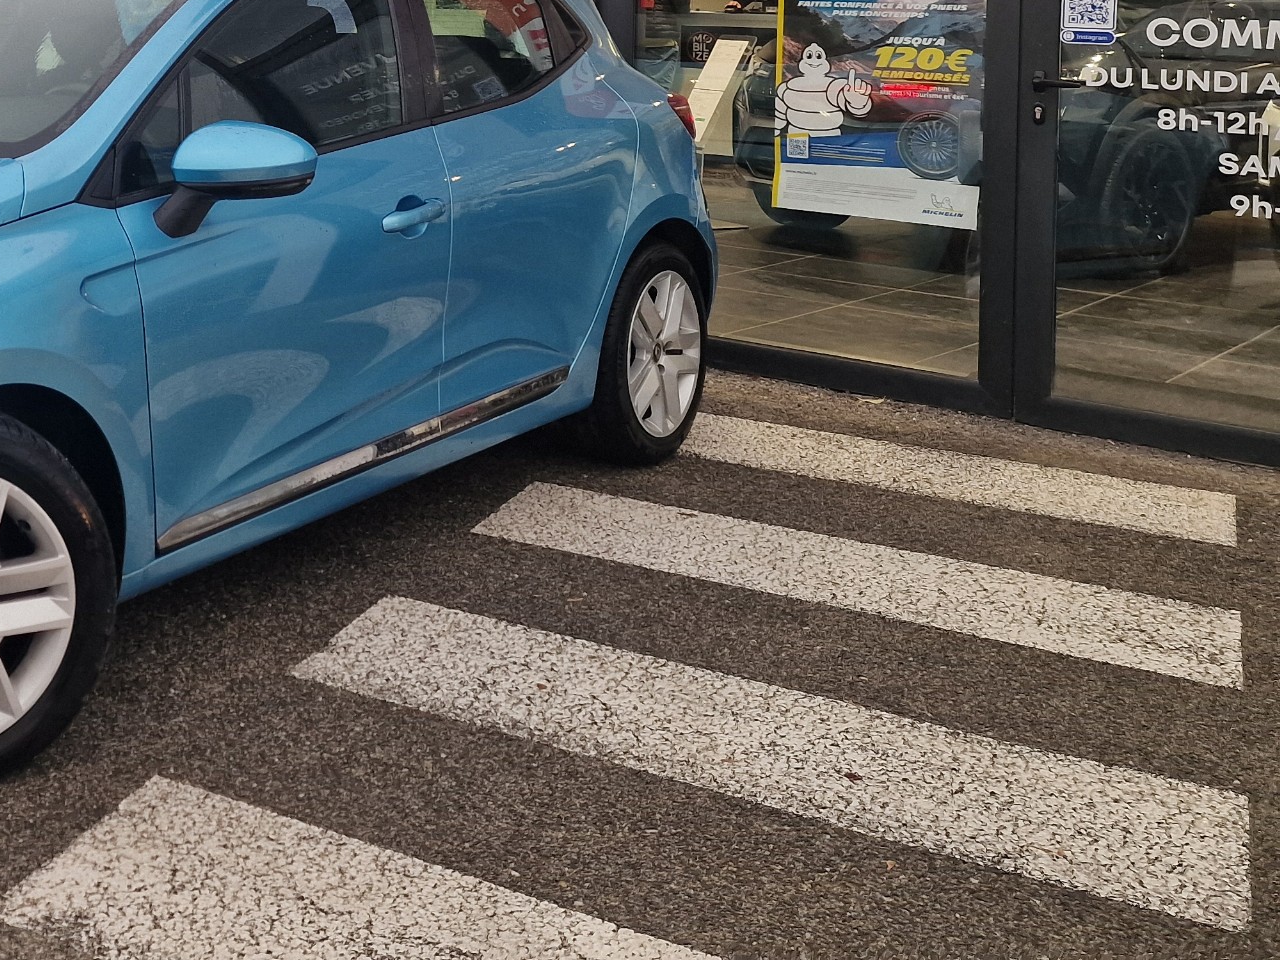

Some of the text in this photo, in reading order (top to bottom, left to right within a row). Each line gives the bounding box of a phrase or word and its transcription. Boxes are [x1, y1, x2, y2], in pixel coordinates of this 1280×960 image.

[797, 0, 833, 8] FAITES
[833, 1, 894, 10] CONFIANCE
[906, 3, 929, 11] VOS
[831, 9, 859, 17] PLUS
[1076, 34, 1108, 42] Instagram
[874, 46, 973, 72] 120€
[872, 69, 971, 83] REMBOURSÉS
[1084, 67, 1133, 89] DU
[1141, 68, 1248, 93] LUNDI
[921, 209, 964, 218] MICHELIN
